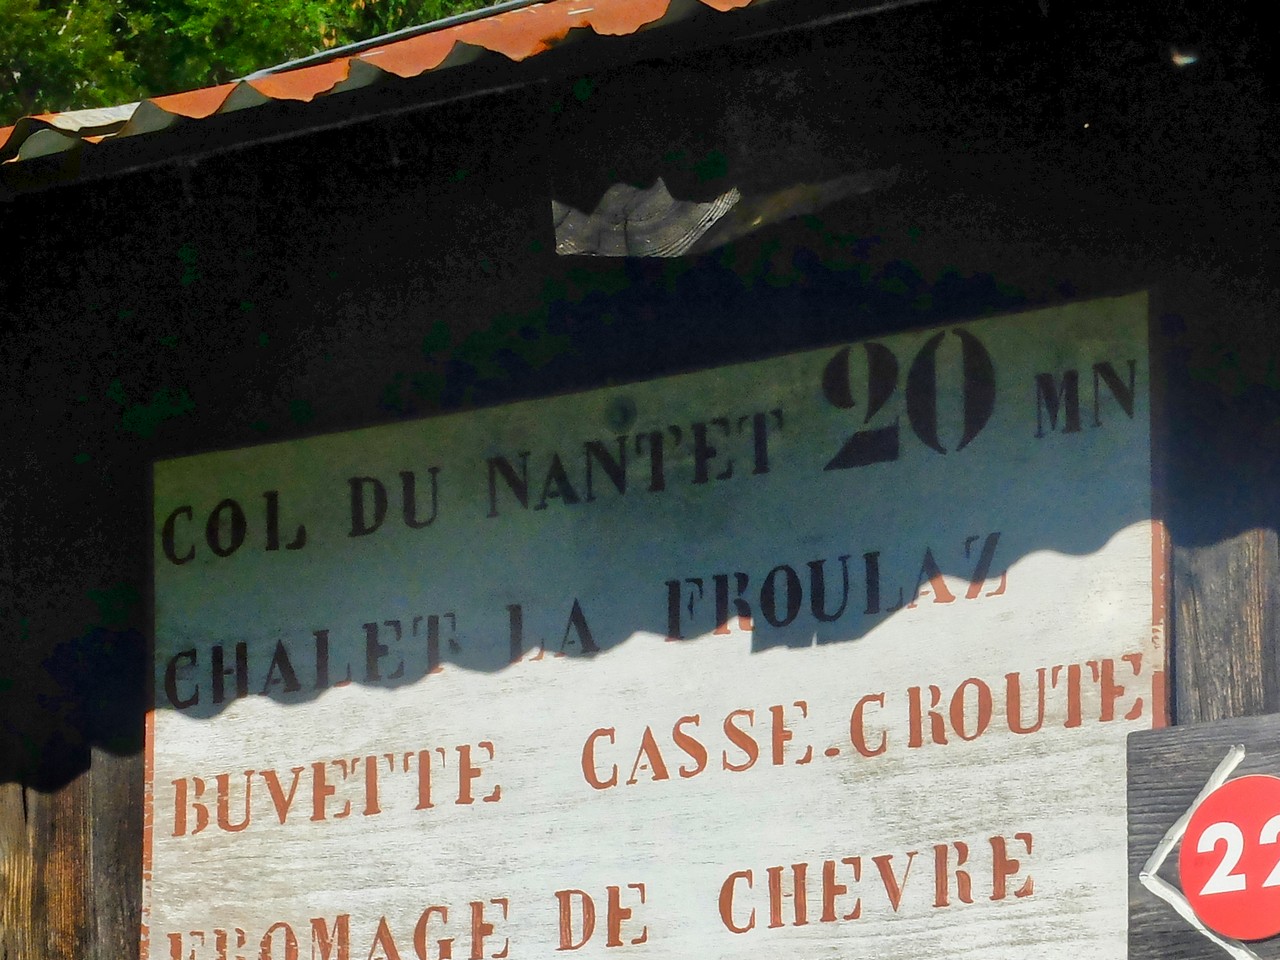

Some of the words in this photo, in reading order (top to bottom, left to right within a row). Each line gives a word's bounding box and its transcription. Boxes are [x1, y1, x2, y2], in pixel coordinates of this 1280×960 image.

[161, 491, 307, 565] COL
[347, 467, 441, 537] DU
[486, 409, 784, 518] NANTET
[822, 328, 996, 470] 20
[1034, 359, 1137, 438] MN
[164, 611, 462, 710] CHALET
[507, 598, 601, 664] LA
[665, 532, 1006, 641] FROULAZ
[171, 741, 501, 836] BUVETTE
[555, 883, 648, 951] DE
[718, 832, 1034, 934] CHEVRE
